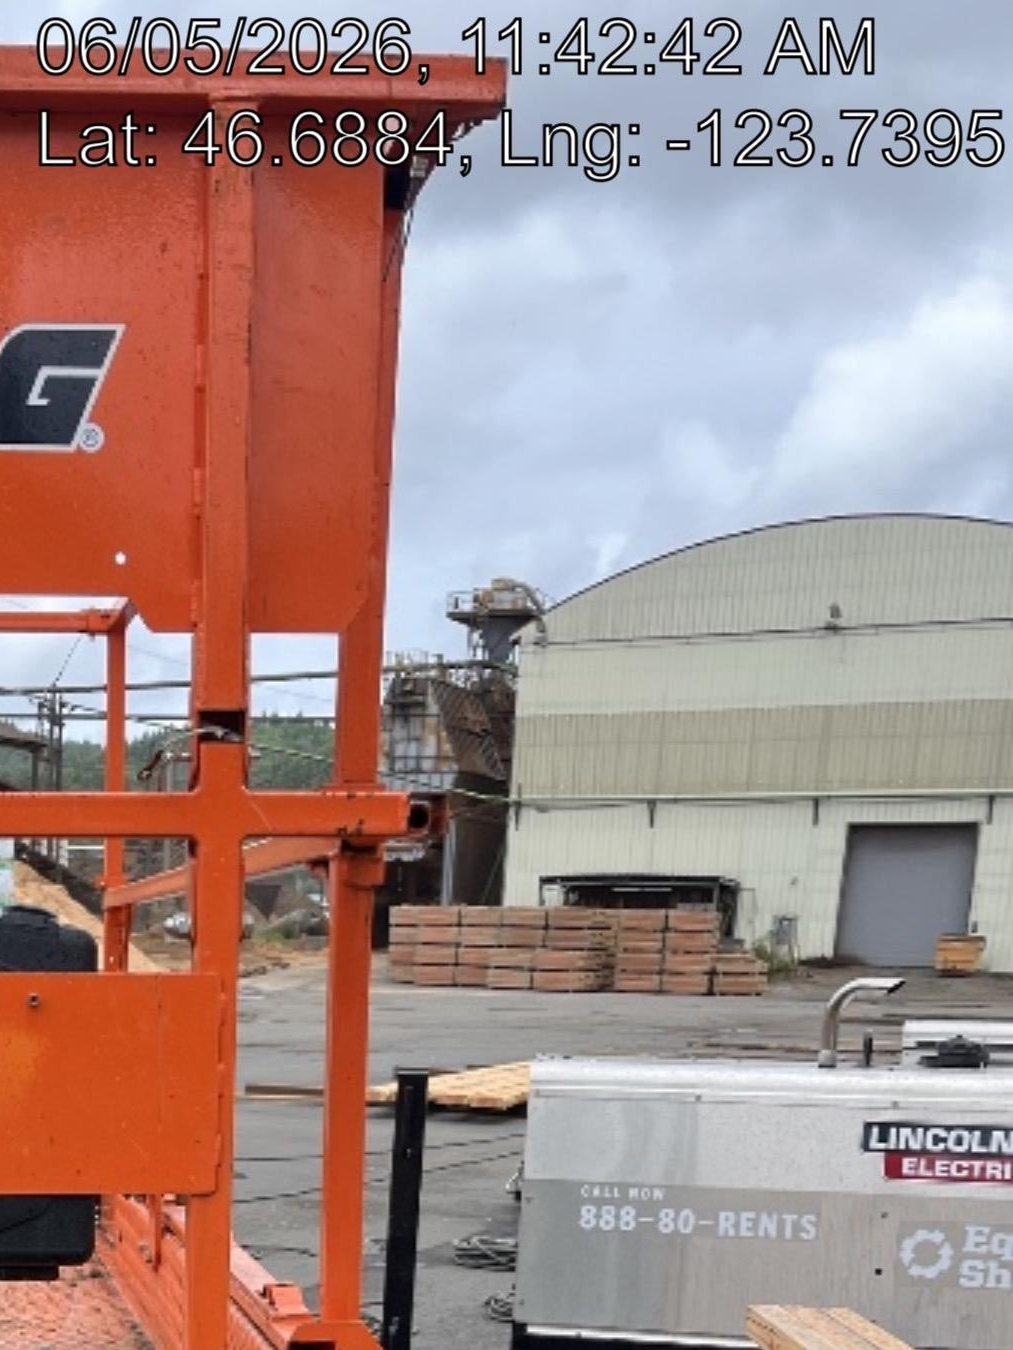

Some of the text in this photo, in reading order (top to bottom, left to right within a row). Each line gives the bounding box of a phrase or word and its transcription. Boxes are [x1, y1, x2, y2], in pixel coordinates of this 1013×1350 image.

[580, 1184, 666, 1200] CALL NOW
[579, 1204, 818, 1241] 888-80-RENTS
